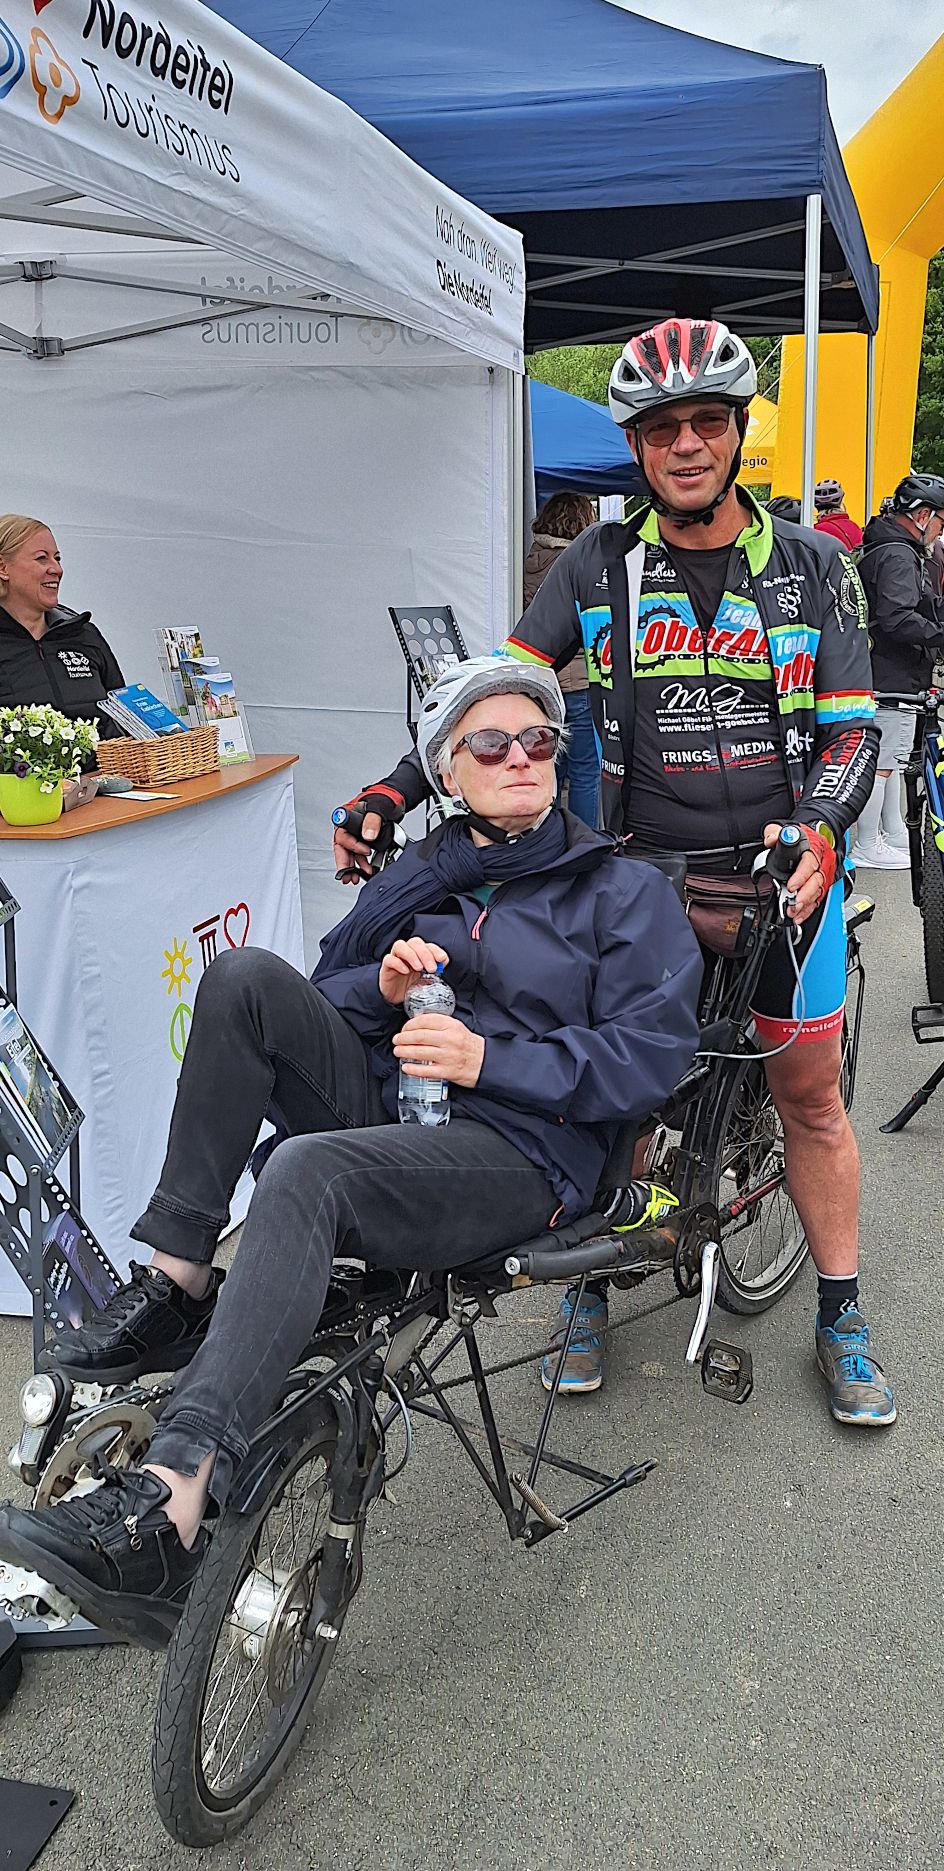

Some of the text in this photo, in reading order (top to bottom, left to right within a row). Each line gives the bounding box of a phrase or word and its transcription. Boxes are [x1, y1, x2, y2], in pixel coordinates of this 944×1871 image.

[81, 57, 241, 183] Tourismus
[435, 204, 455, 249] Nah
[457, 221, 480, 265] dran.
[742, 455, 768, 469] egio
[729, 740, 775, 758] MEDIA
[812, 764, 847, 797] STOLL
[843, 1344, 868, 1354] GIRO
